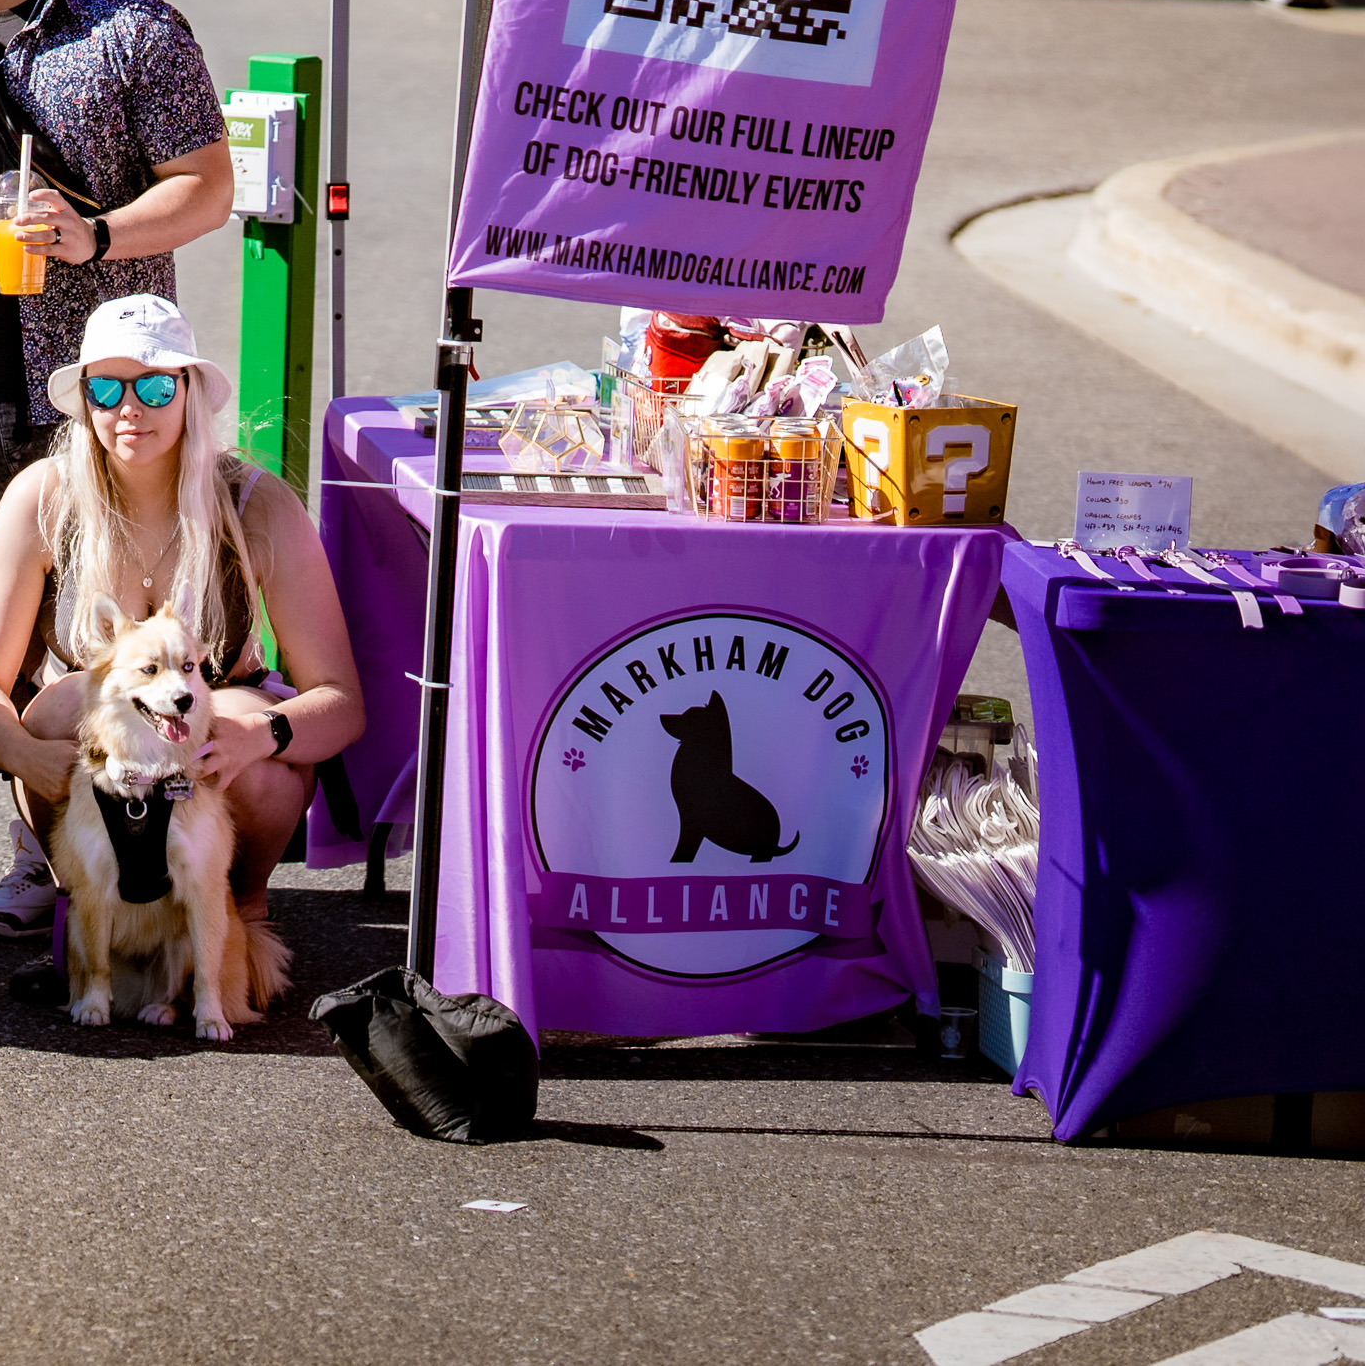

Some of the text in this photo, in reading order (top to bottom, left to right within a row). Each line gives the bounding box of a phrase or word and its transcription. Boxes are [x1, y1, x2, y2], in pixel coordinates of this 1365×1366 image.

[513, 80, 896, 163] CHECK OUT OUR FULL LINEUP
[522, 139, 865, 214] OF DOG-FRIENDLY EVENTS
[484, 223, 866, 296] WWW.MARKHAMDOGALLIANCE.COM
[1109, 479, 1124, 487] FREE
[571, 634, 871, 746] MARKHAM DOG
[568, 881, 842, 927] ALLIANCE
